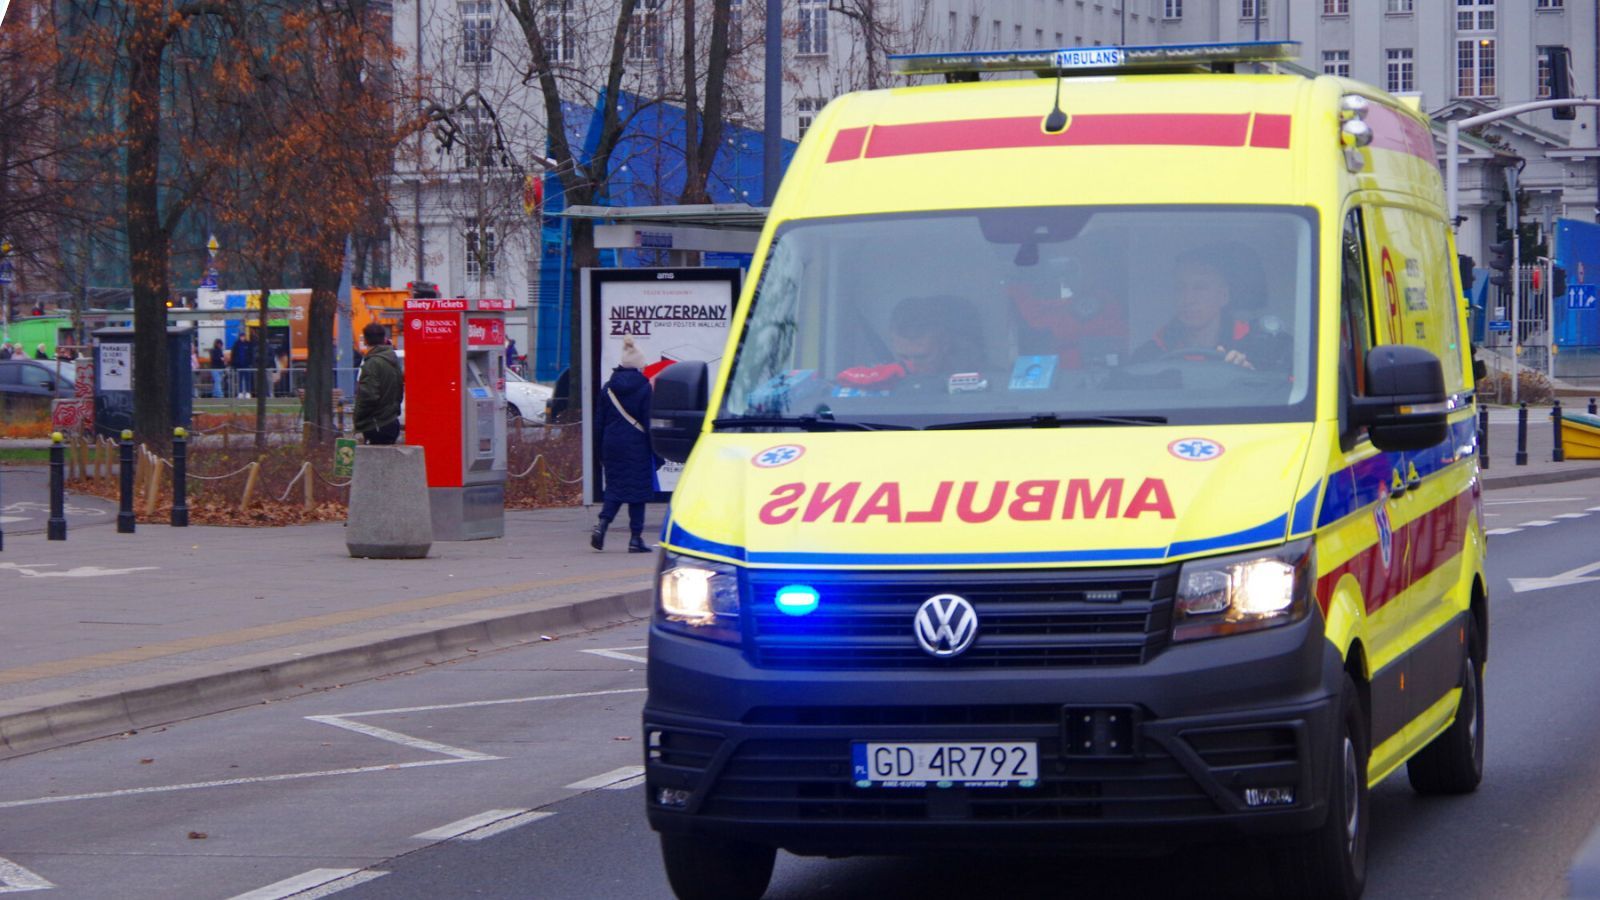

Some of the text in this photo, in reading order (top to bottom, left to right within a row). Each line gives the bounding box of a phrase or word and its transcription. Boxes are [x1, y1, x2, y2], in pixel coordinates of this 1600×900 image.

[1056, 51, 1118, 65] AMBULANS
[407, 301, 430, 310] Bilety
[436, 301, 464, 309] Tickets
[610, 305, 727, 320] NIEWYCZERPANY
[875, 746, 1029, 777] GD 4R792
[855, 765, 867, 774] PL
